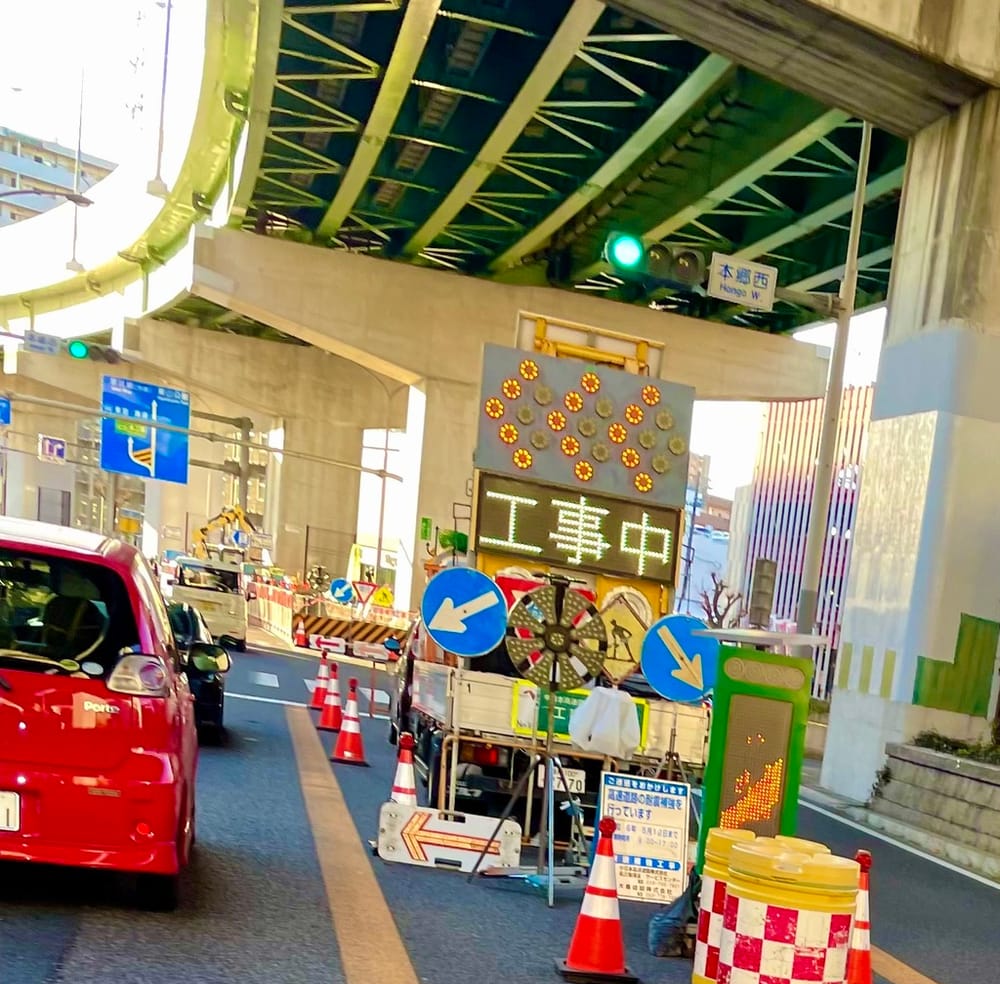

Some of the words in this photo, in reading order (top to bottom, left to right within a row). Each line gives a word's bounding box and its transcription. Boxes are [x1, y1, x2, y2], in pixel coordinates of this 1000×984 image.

[479, 490, 672, 577] 工事中
[607, 803, 652, 820] 行っています
